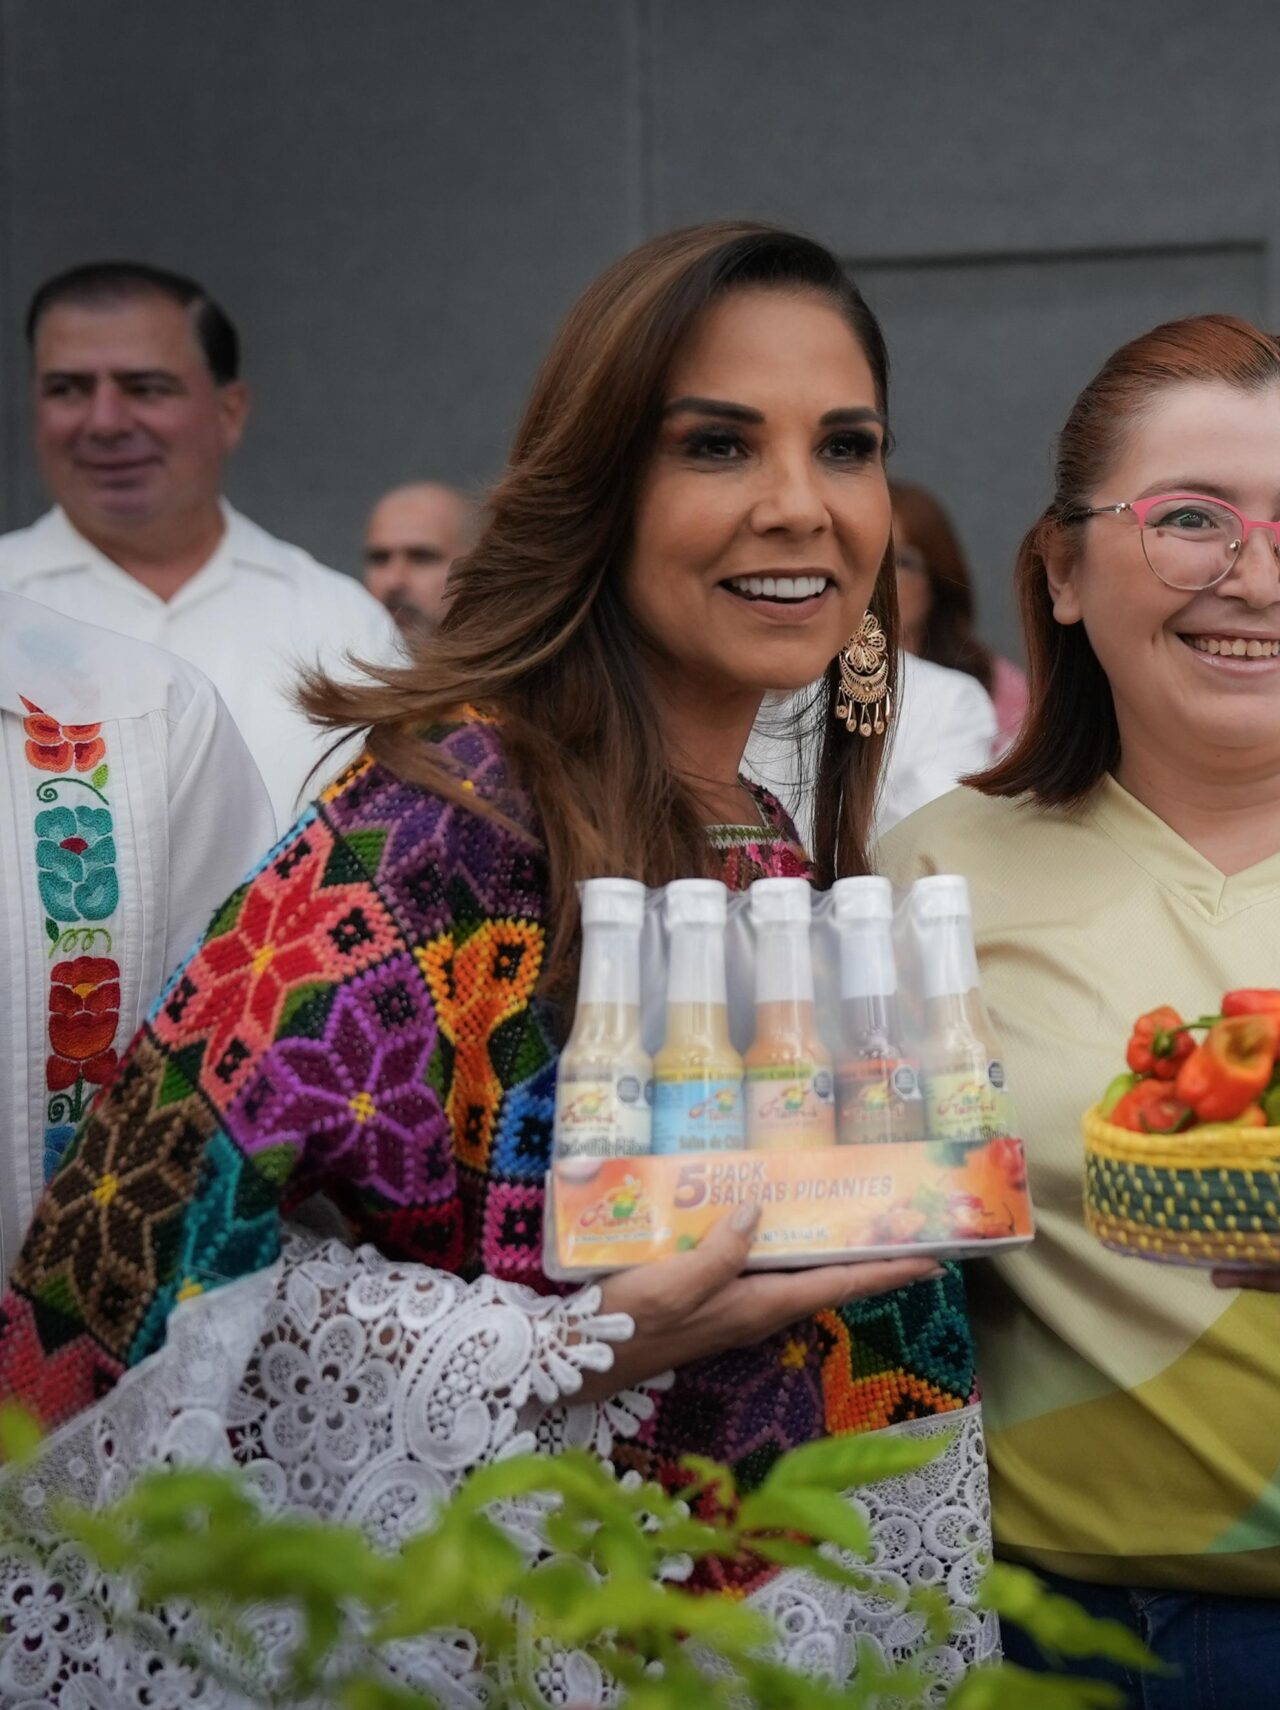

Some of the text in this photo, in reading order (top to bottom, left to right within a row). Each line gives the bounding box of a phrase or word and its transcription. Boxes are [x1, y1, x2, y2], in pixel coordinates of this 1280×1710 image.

[674, 1162, 764, 1209] 5 PACK
[709, 1176, 892, 1206] SALSAS PICANTES
